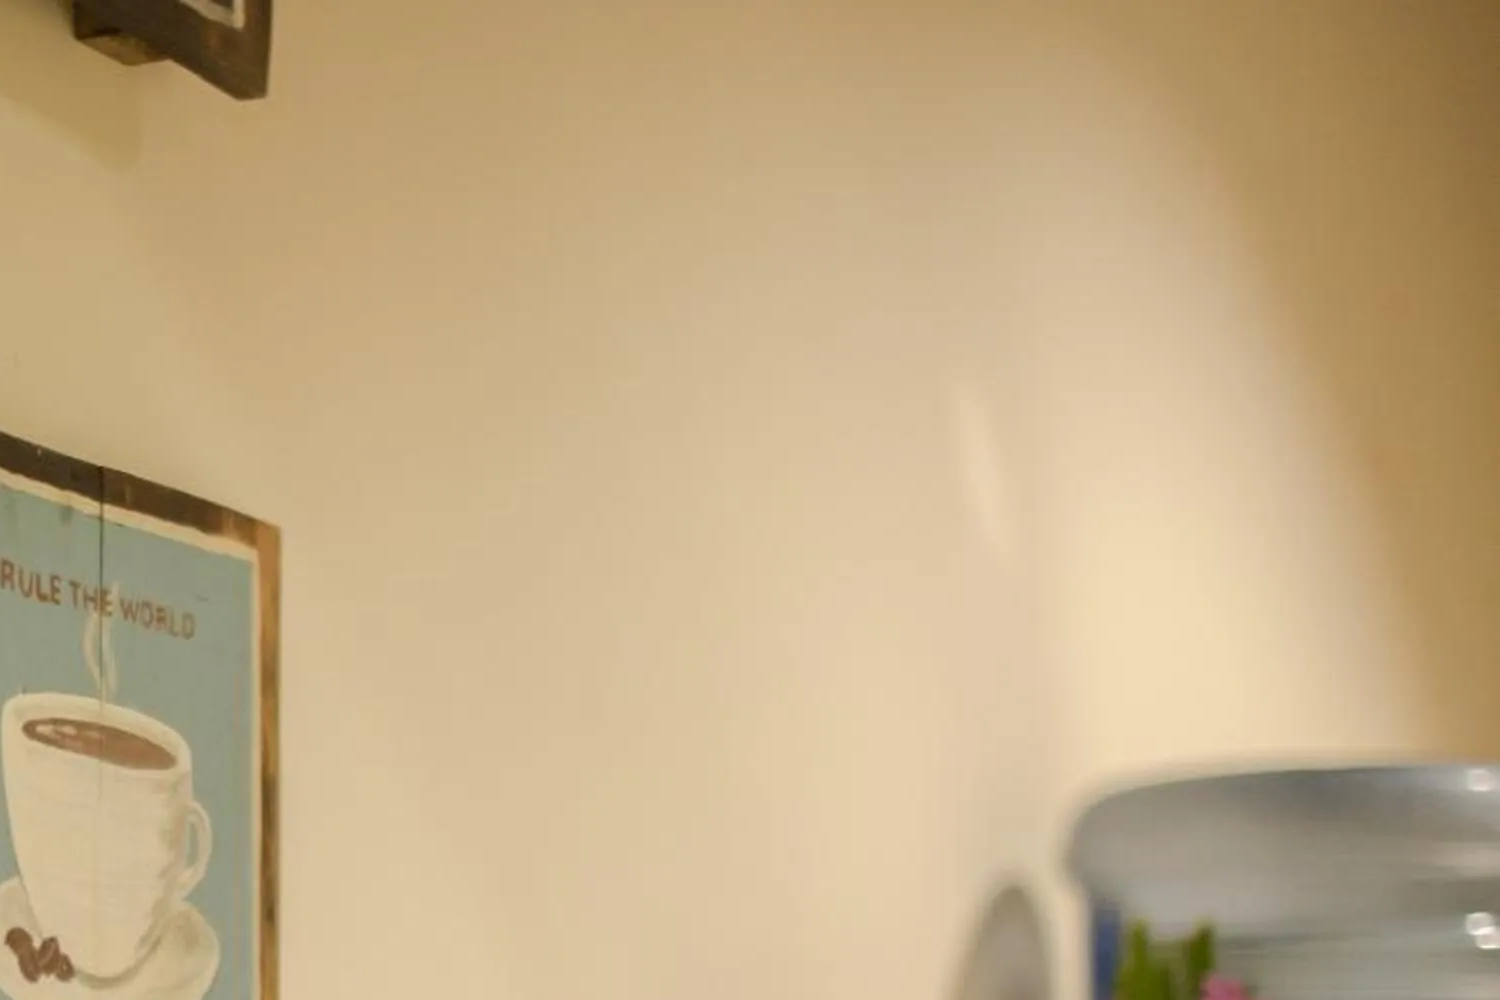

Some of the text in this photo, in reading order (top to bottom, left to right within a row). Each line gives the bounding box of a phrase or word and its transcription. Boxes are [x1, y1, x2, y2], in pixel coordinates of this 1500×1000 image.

[0, 557, 196, 640] RULE THE WORLD
